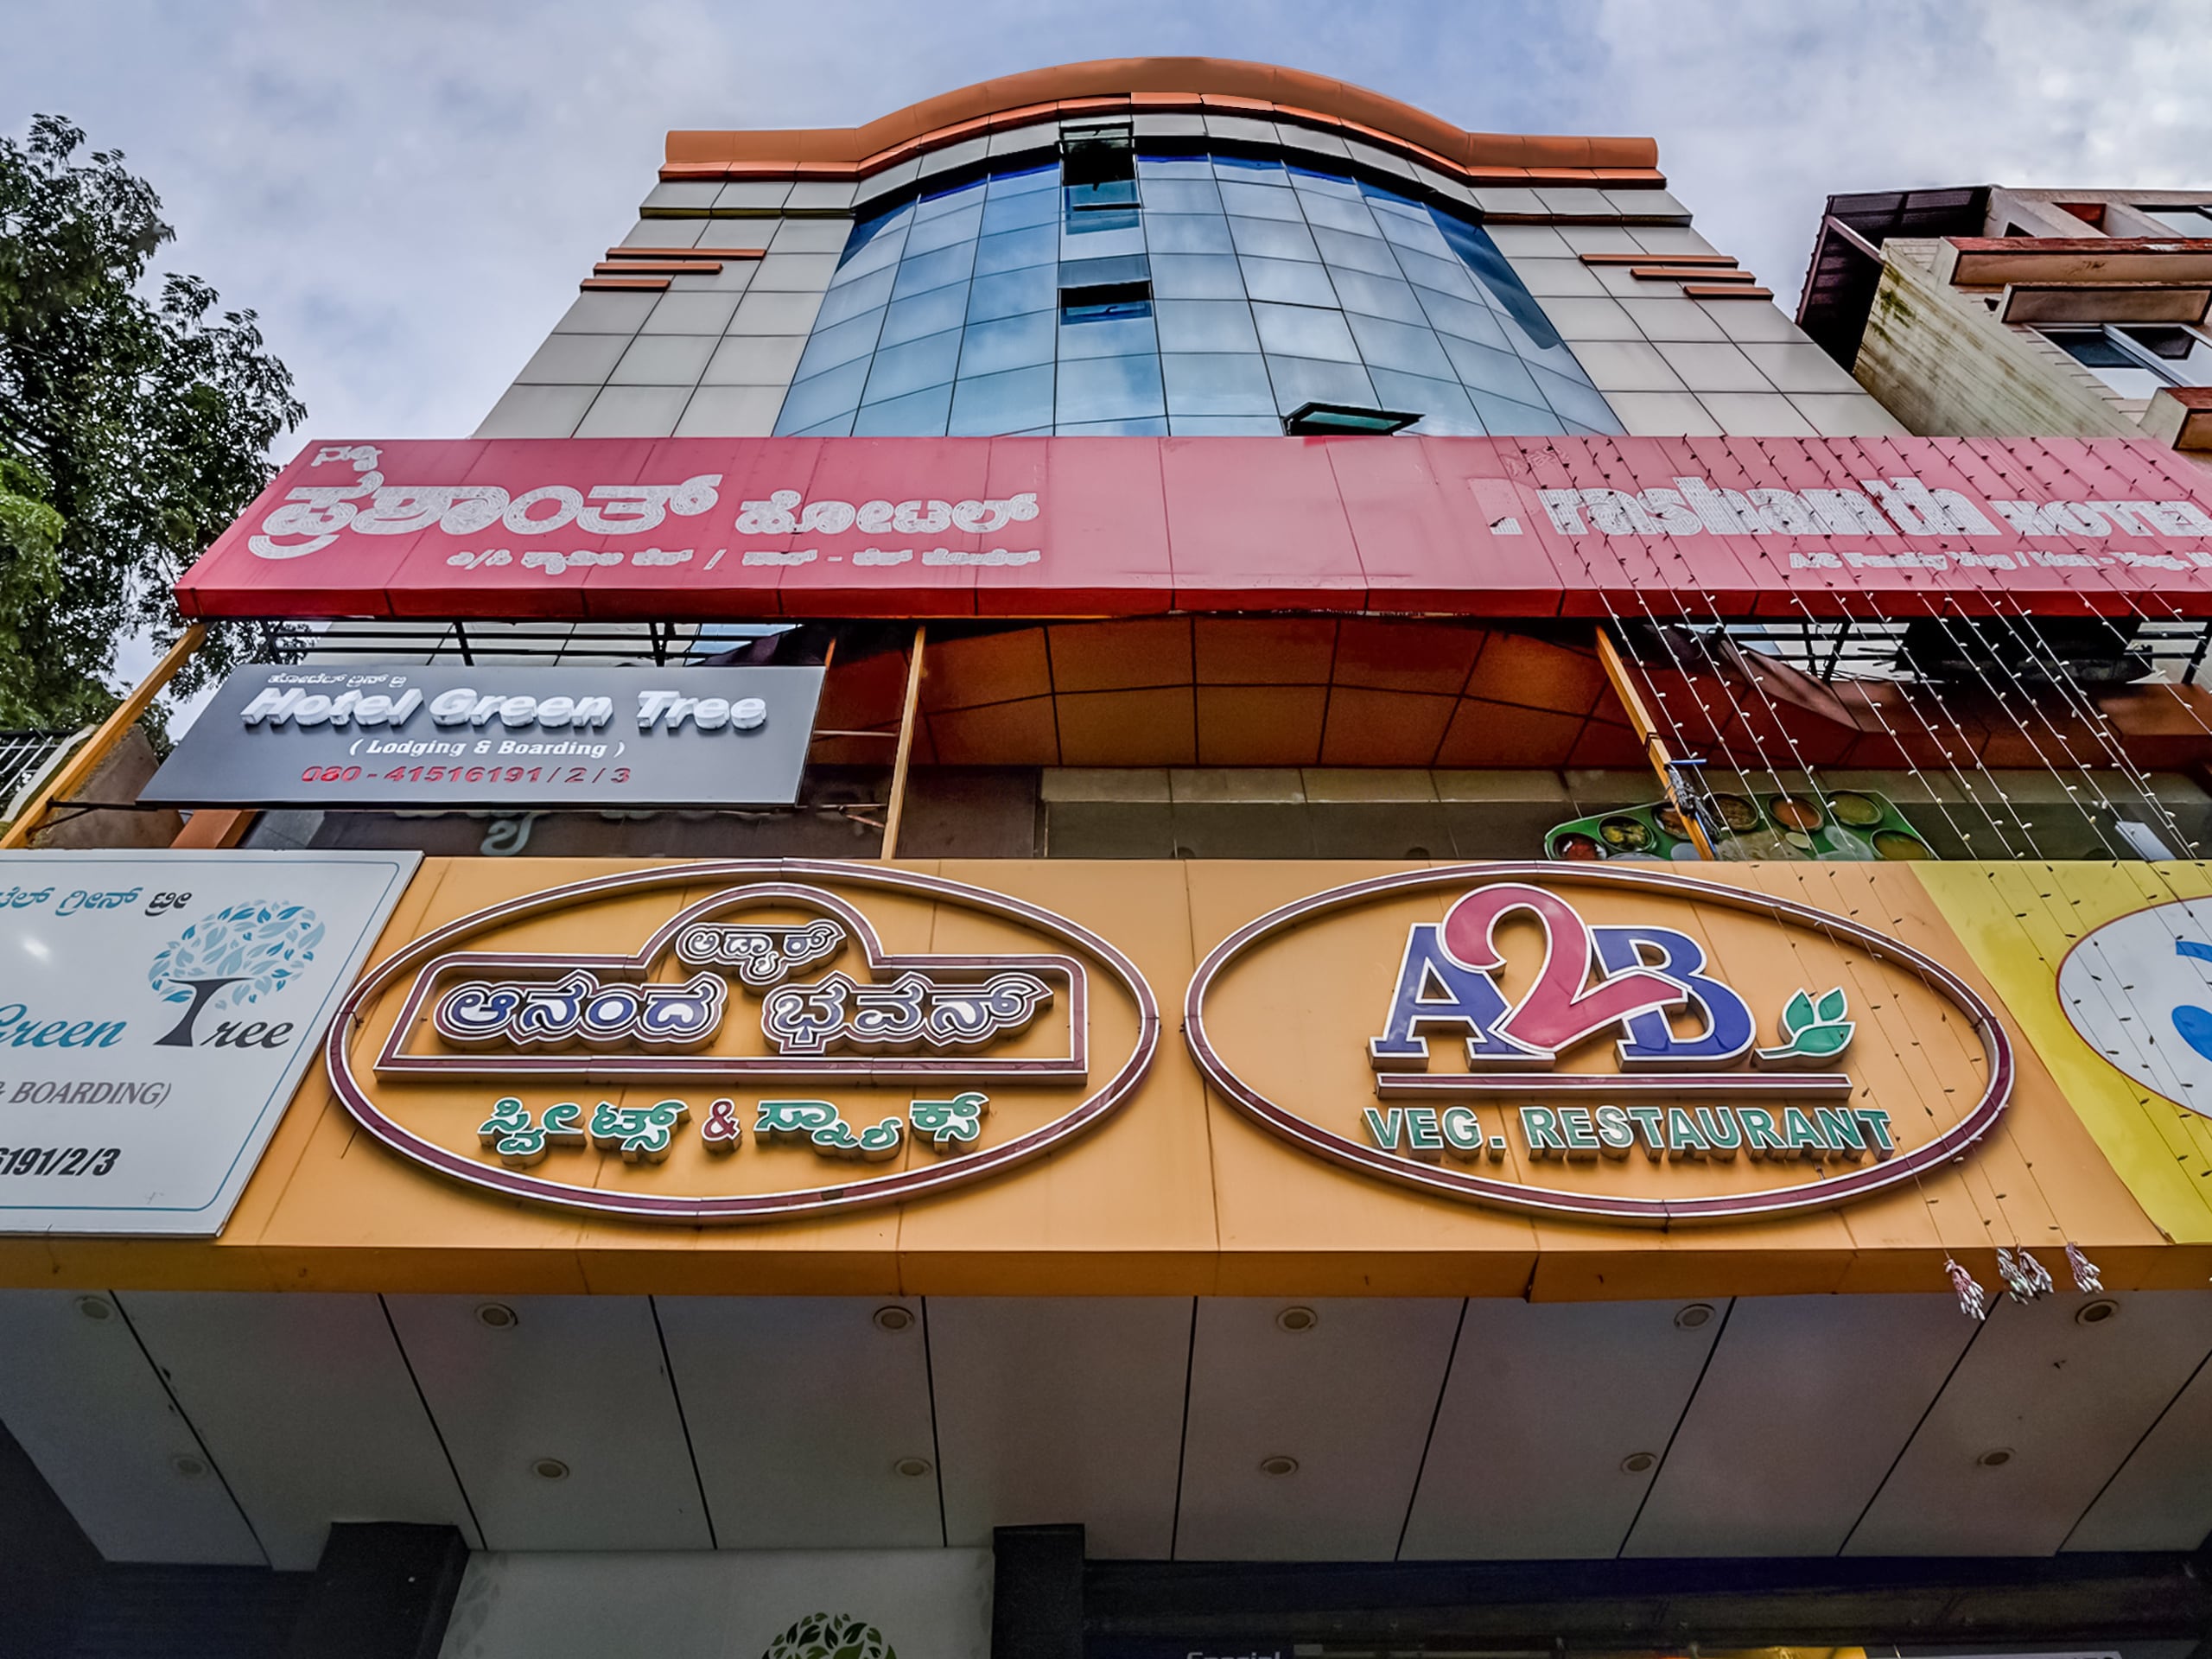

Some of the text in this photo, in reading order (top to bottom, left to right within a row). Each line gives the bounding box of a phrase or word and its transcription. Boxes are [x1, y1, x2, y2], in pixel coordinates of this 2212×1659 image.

[240, 687, 768, 730] Hotel Green Tree
[474, 741, 494, 754] &
[1369, 881, 1757, 1066] A2B
[442, 977, 1043, 1047] ಆನಂದ ಭವನ್
[8, 1081, 172, 1109] BOARDING)
[701, 1097, 741, 1146] &
[1362, 1106, 1897, 1158] VEG. RESTAURANT
